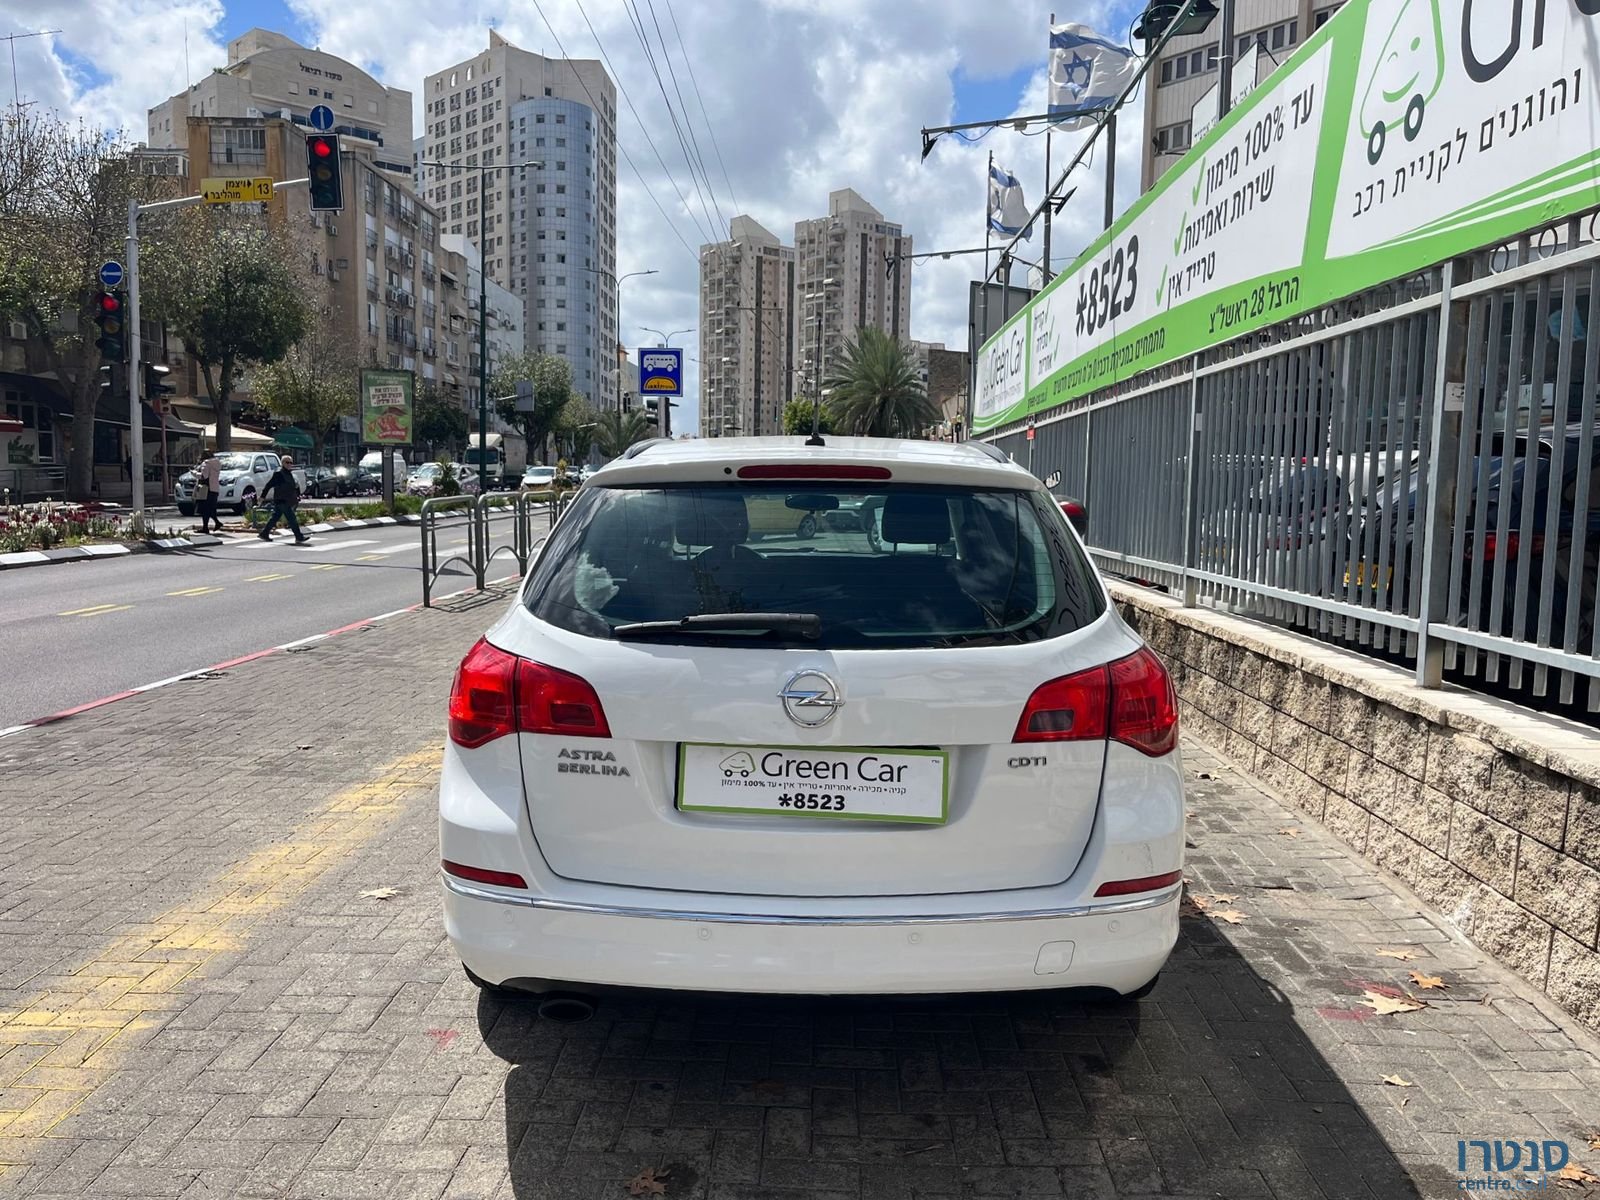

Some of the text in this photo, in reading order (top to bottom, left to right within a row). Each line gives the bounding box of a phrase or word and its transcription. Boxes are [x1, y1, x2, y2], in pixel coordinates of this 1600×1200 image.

[1291, 83, 1315, 130] עד
[1244, 105, 1284, 166] 100%
[1352, 68, 1582, 218] והוגנים לקניית רכב
[226, 180, 246, 189] ויצמן
[1206, 146, 1239, 206] מימון
[210, 190, 240, 199] מוהליבר
[257, 184, 269, 194] 13
[1183, 165, 1275, 254] שירות ואמינות
[1167, 251, 1215, 311] טרייד אין
[1250, 286, 1265, 318] 28
[1269, 276, 1299, 311] הרצל
[1135, 327, 1165, 360] מתמחים
[558, 748, 616, 762] ASTRA
[1008, 756, 1047, 768] CDTI
[558, 763, 630, 777] BERLINA
[761, 752, 908, 782] Green Car
[784, 782, 794, 790] אין
[797, 782, 818, 790] טרייד
[858, 785, 882, 793] מכירה
[888, 787, 906, 796] קניה
